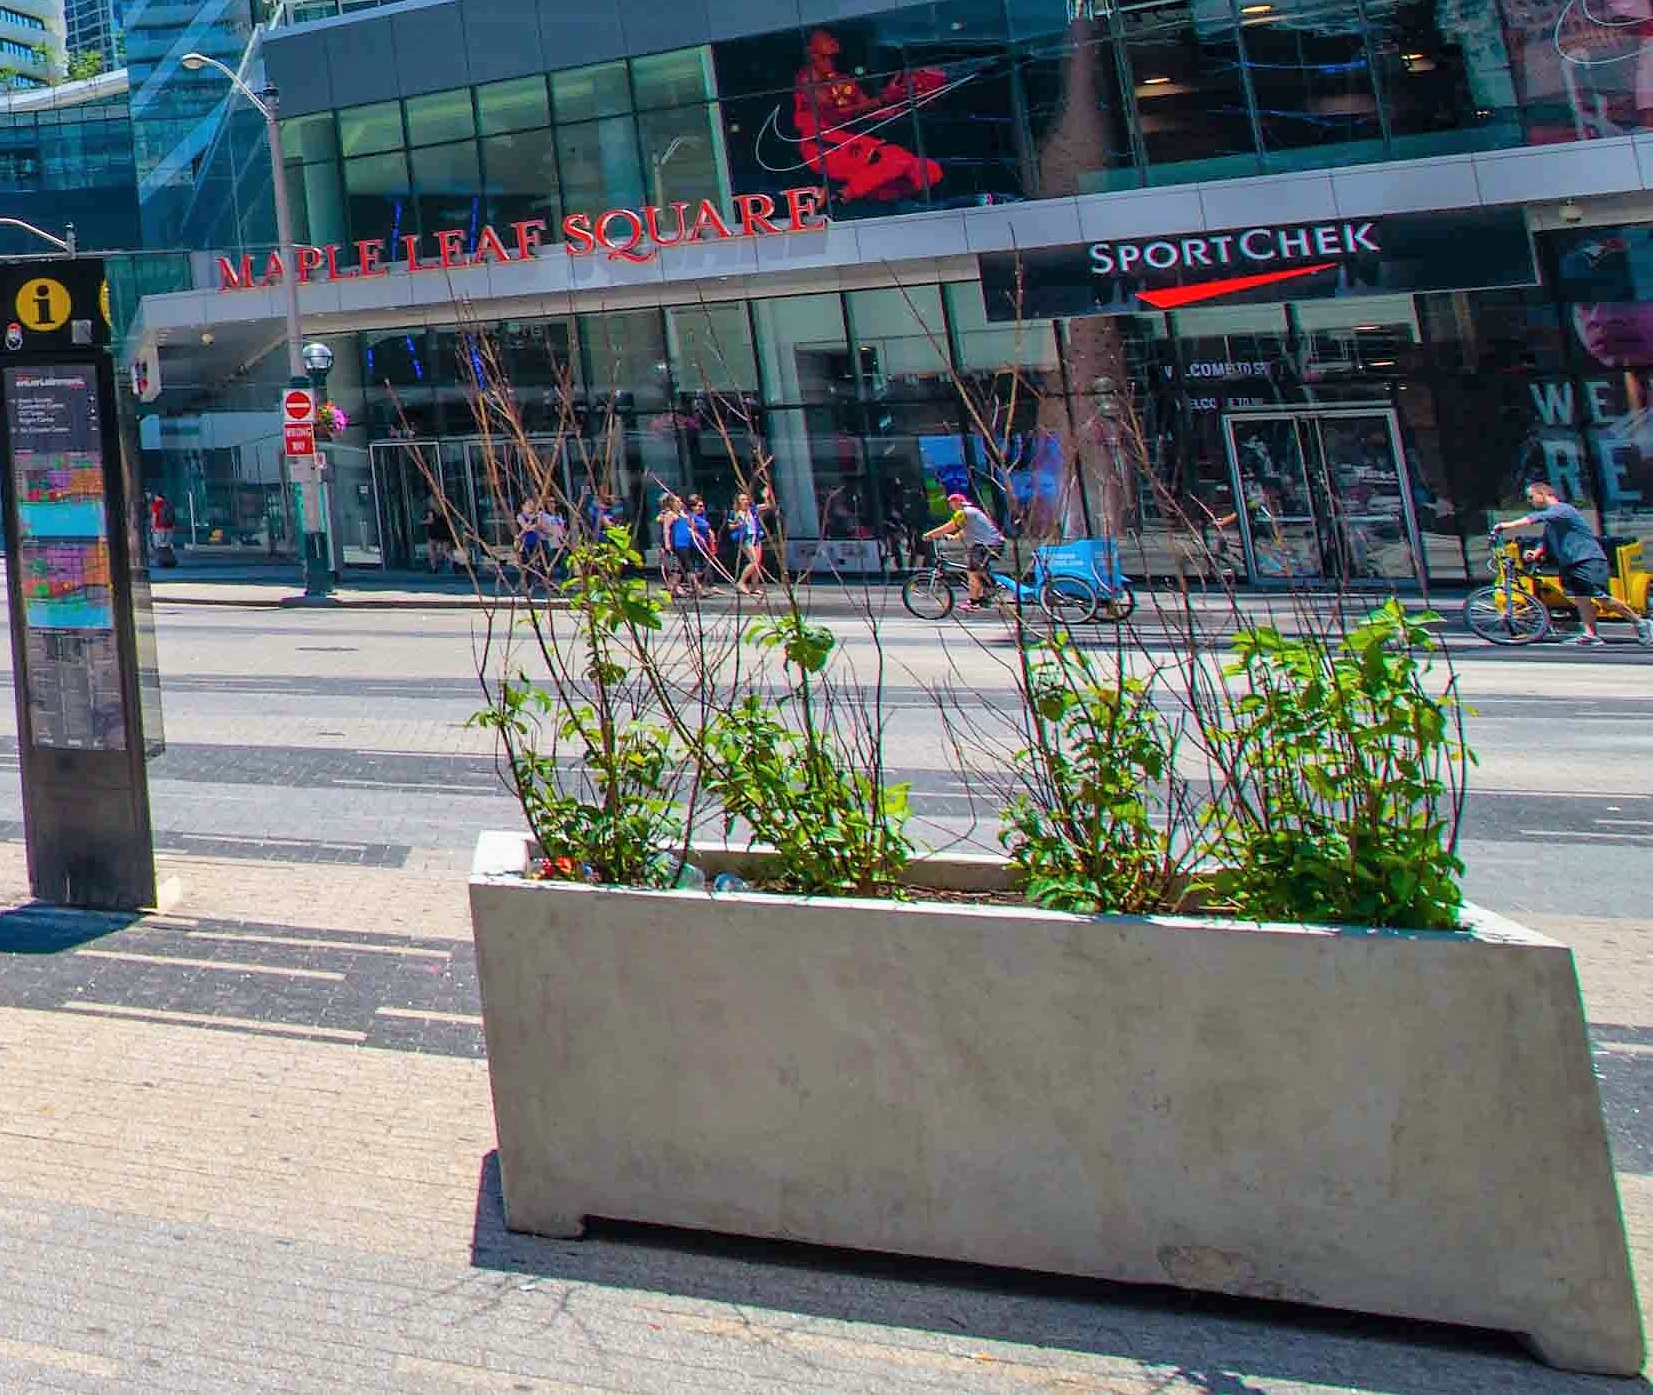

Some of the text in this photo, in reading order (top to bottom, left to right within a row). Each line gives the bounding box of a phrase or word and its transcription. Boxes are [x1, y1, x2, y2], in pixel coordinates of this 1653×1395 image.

[216, 186, 828, 293] MAPLE LEAF SQUARE
